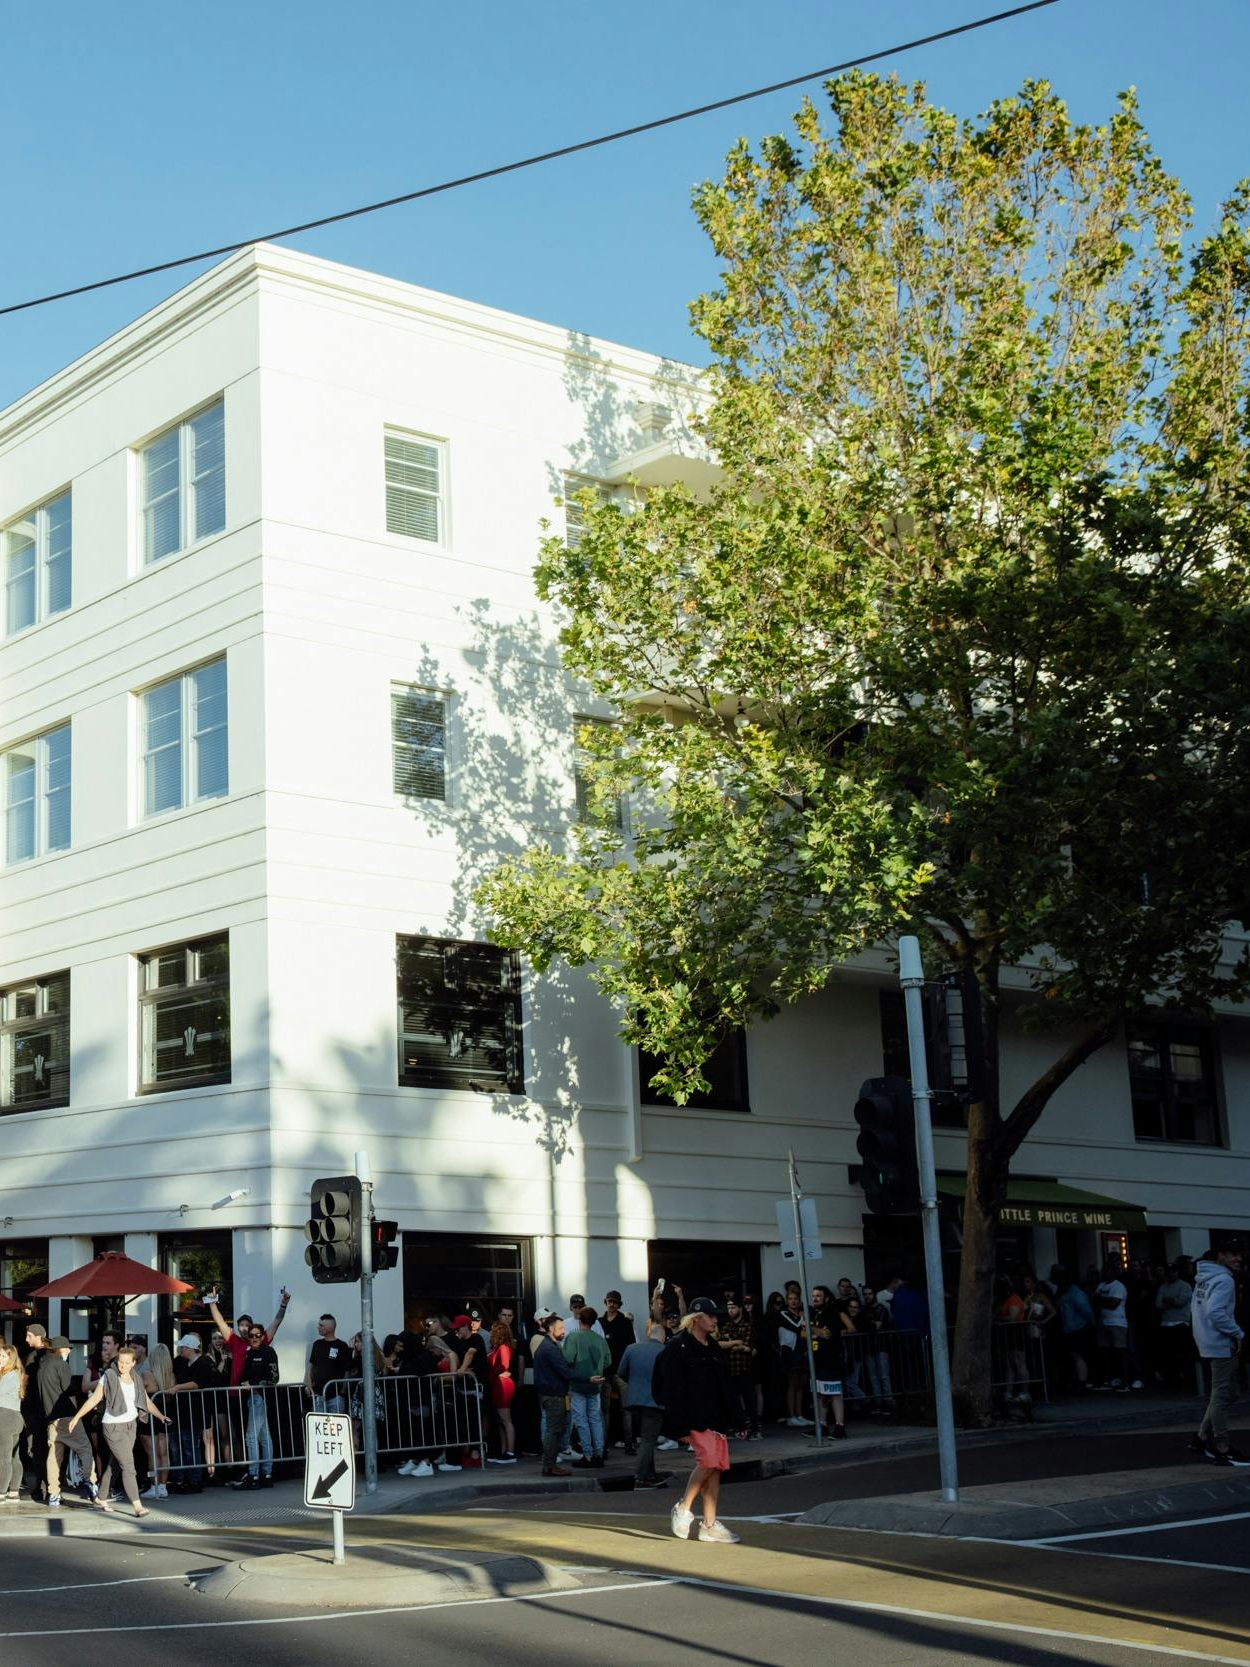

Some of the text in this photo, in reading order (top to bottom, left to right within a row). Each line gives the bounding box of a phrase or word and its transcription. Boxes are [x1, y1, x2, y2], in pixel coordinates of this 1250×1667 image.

[1001, 1208, 1112, 1225] ITTLE PRINCE WINE
[315, 1422, 343, 1437] KEEP
[316, 1441, 343, 1456] LEFT
